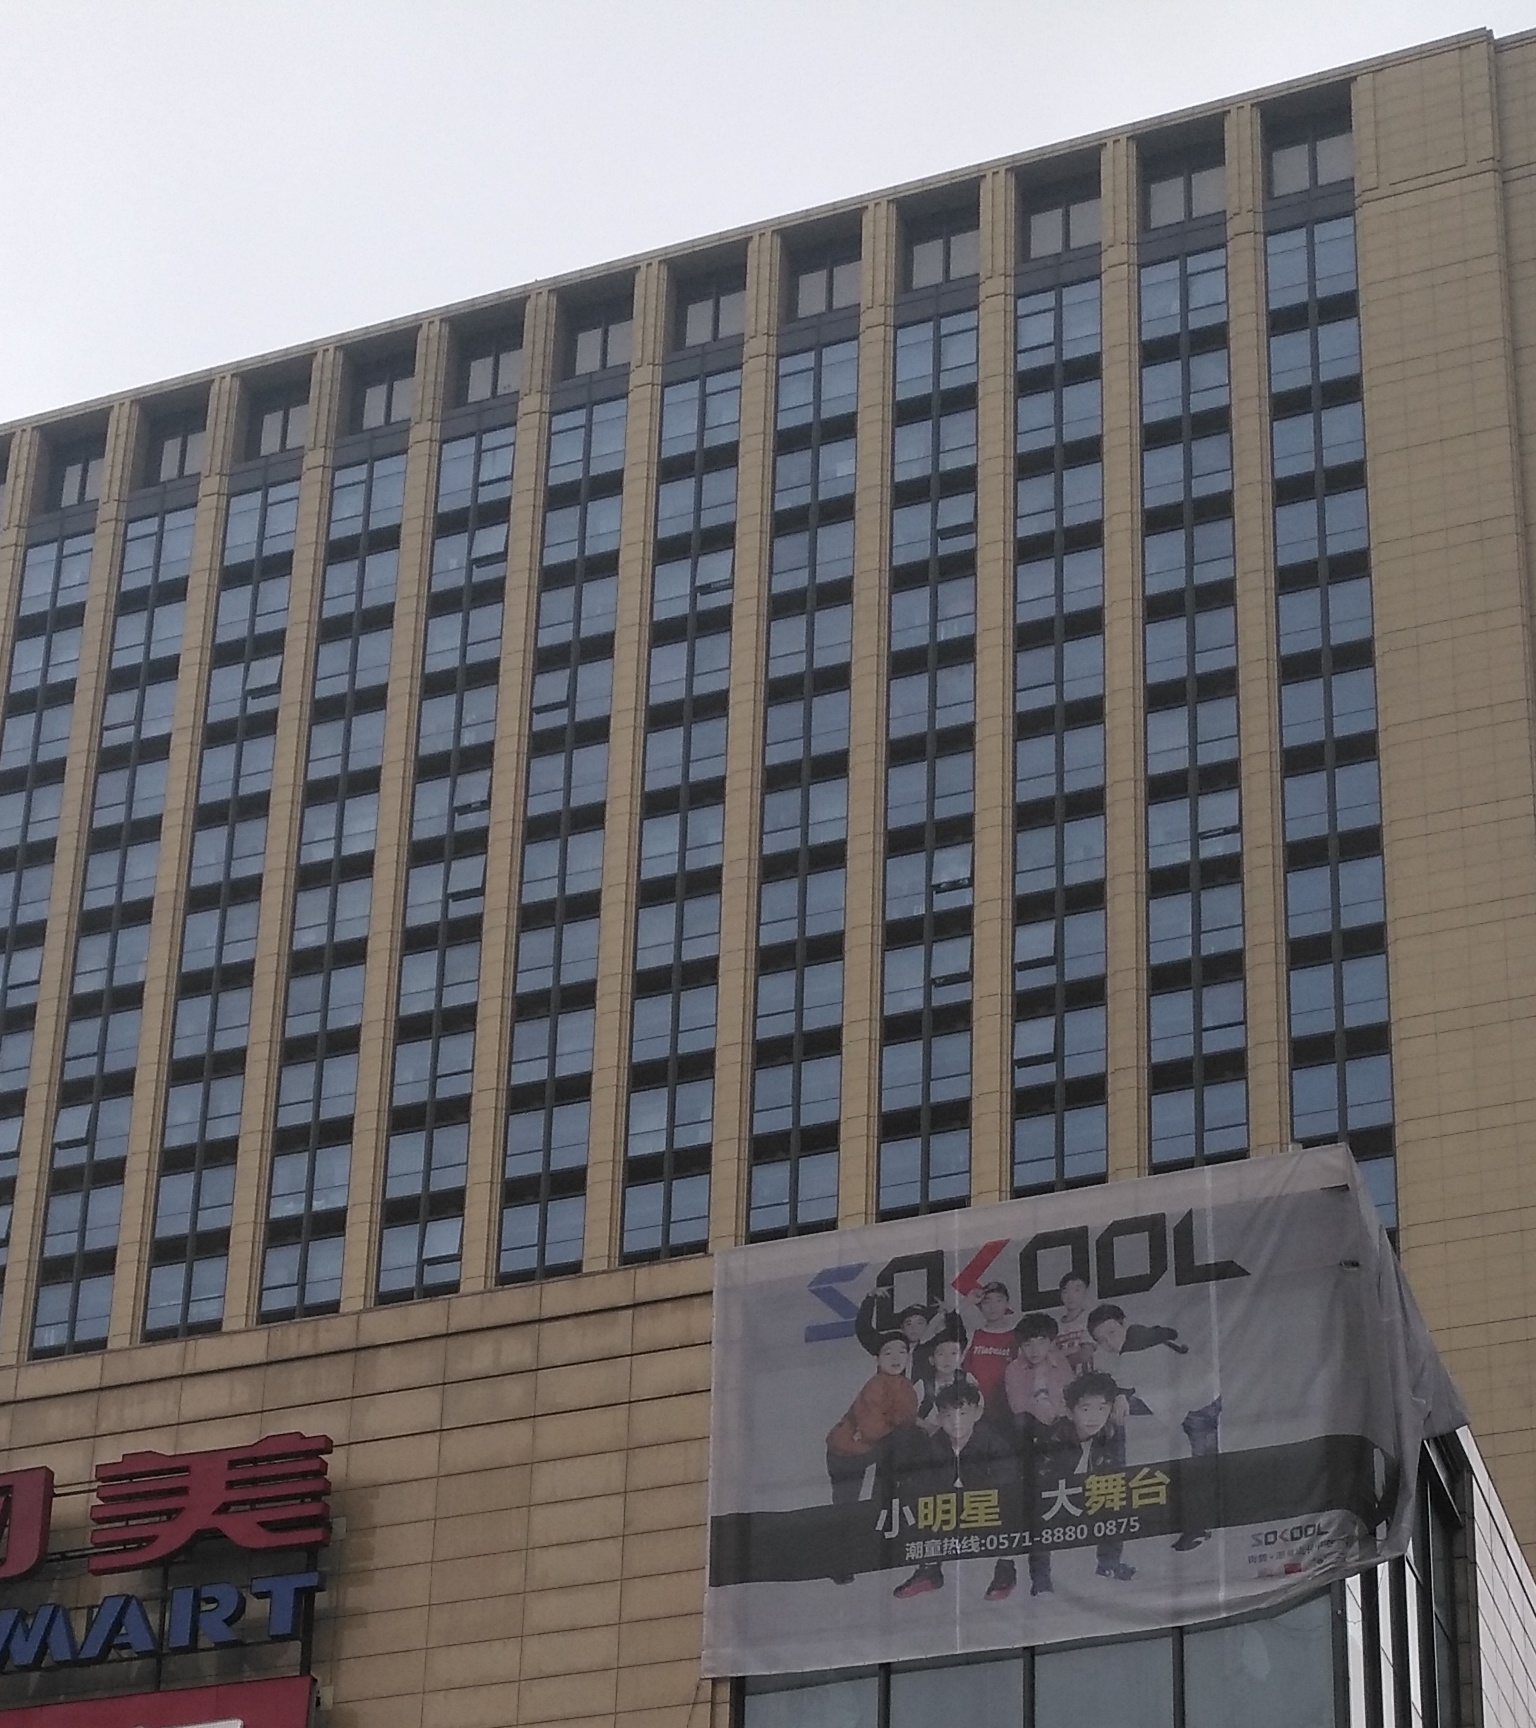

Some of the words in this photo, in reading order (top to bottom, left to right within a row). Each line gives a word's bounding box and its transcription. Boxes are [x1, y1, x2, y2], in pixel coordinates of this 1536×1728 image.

[875, 1488, 1002, 1539] 小明星
[1041, 1467, 1171, 1521] 大舞台
[1092, 1516, 1141, 1539] 0875
